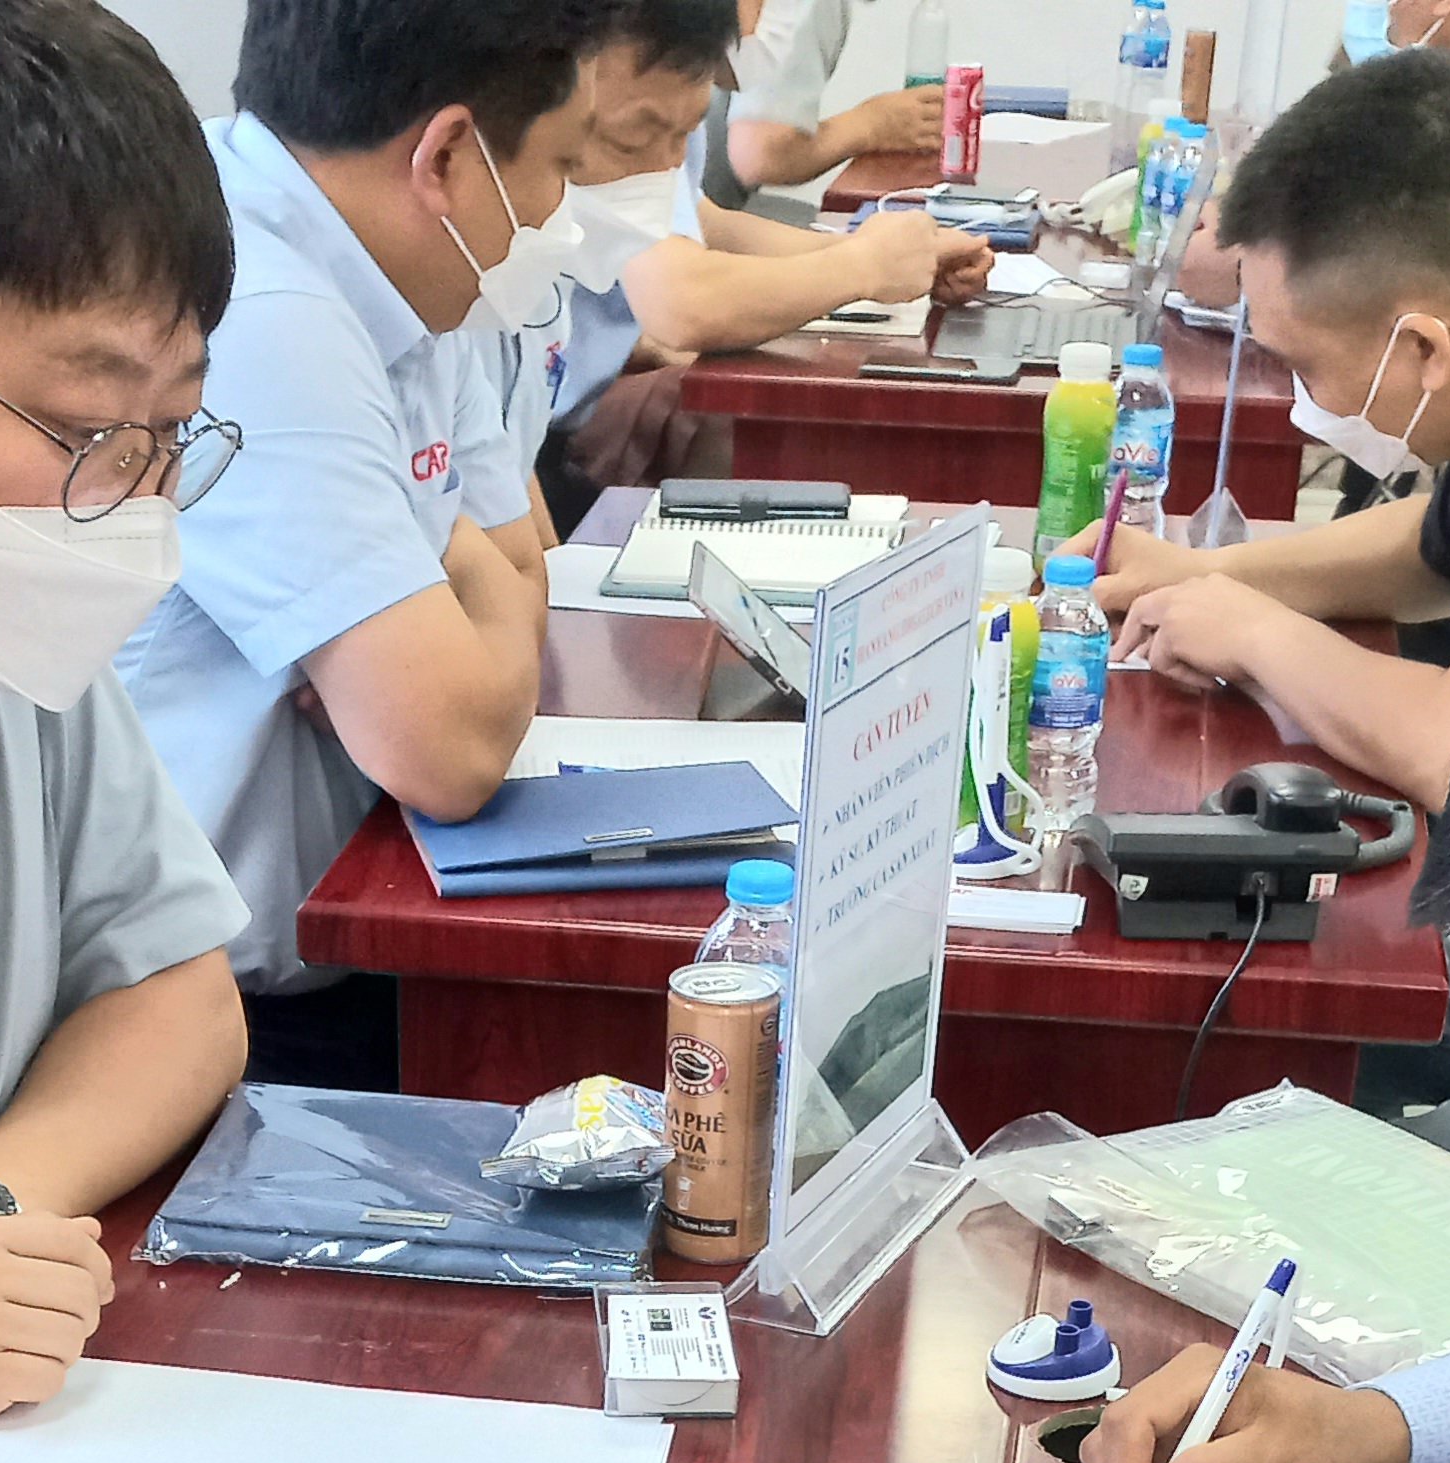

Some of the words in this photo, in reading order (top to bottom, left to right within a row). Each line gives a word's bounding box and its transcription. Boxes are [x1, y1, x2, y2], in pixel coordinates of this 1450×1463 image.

[831, 642, 851, 687] 15
[684, 1111, 727, 1134] PHÊ
[671, 1128, 707, 1154] SỮA
